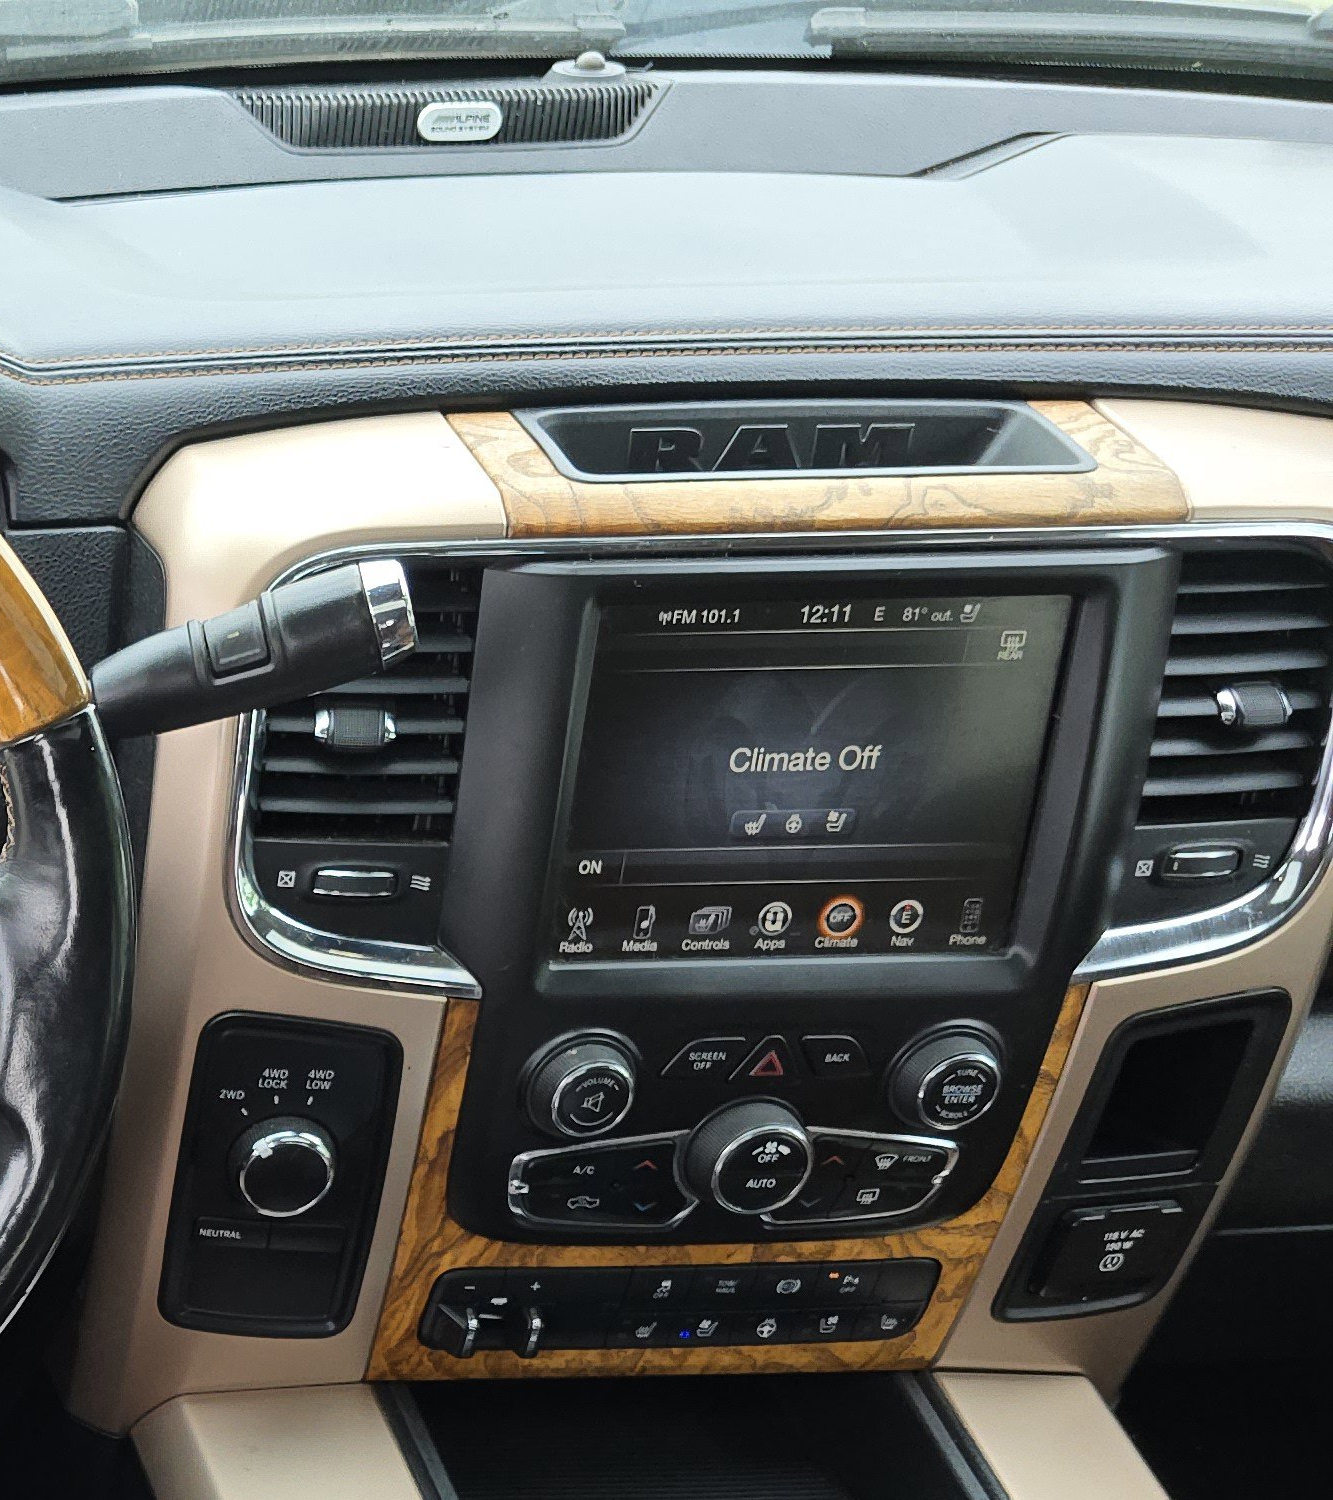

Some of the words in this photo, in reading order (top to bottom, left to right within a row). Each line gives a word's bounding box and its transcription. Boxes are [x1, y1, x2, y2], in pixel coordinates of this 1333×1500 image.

[627, 423, 916, 471] RAM
[673, 609, 695, 624] FM
[700, 609, 740, 624] 101.1
[801, 604, 852, 623] 12:11
[874, 606, 886, 621] E
[997, 650, 1023, 661] REAR
[729, 747, 832, 773] Climate
[838, 744, 883, 771] Off
[578, 859, 602, 875] ON
[681, 938, 730, 951] Controls
[754, 938, 786, 951] Apps
[814, 936, 858, 949] Climate
[890, 935, 915, 947] Nav
[948, 933, 988, 946] Phone
[559, 940, 593, 953] Radio
[622, 940, 658, 952] Media
[688, 1052, 727, 1061] SCREEN
[824, 1053, 850, 1063] BACK
[693, 1062, 712, 1070] OFF
[262, 1068, 289, 1079] 4WD
[307, 1069, 335, 1080] 4WD
[258, 1079, 288, 1089] LOCK
[306, 1080, 333, 1090] LOW
[582, 1077, 616, 1088] VOLUME
[219, 1089, 245, 1100] 2WD
[942, 1084, 984, 1094] BROWSE
[944, 1095, 976, 1104] ENTER
[757, 1153, 779, 1164] OFF
[573, 1165, 595, 1175] A/C
[746, 1178, 776, 1188] AUTO
[199, 1228, 242, 1240] NEUTRAL
